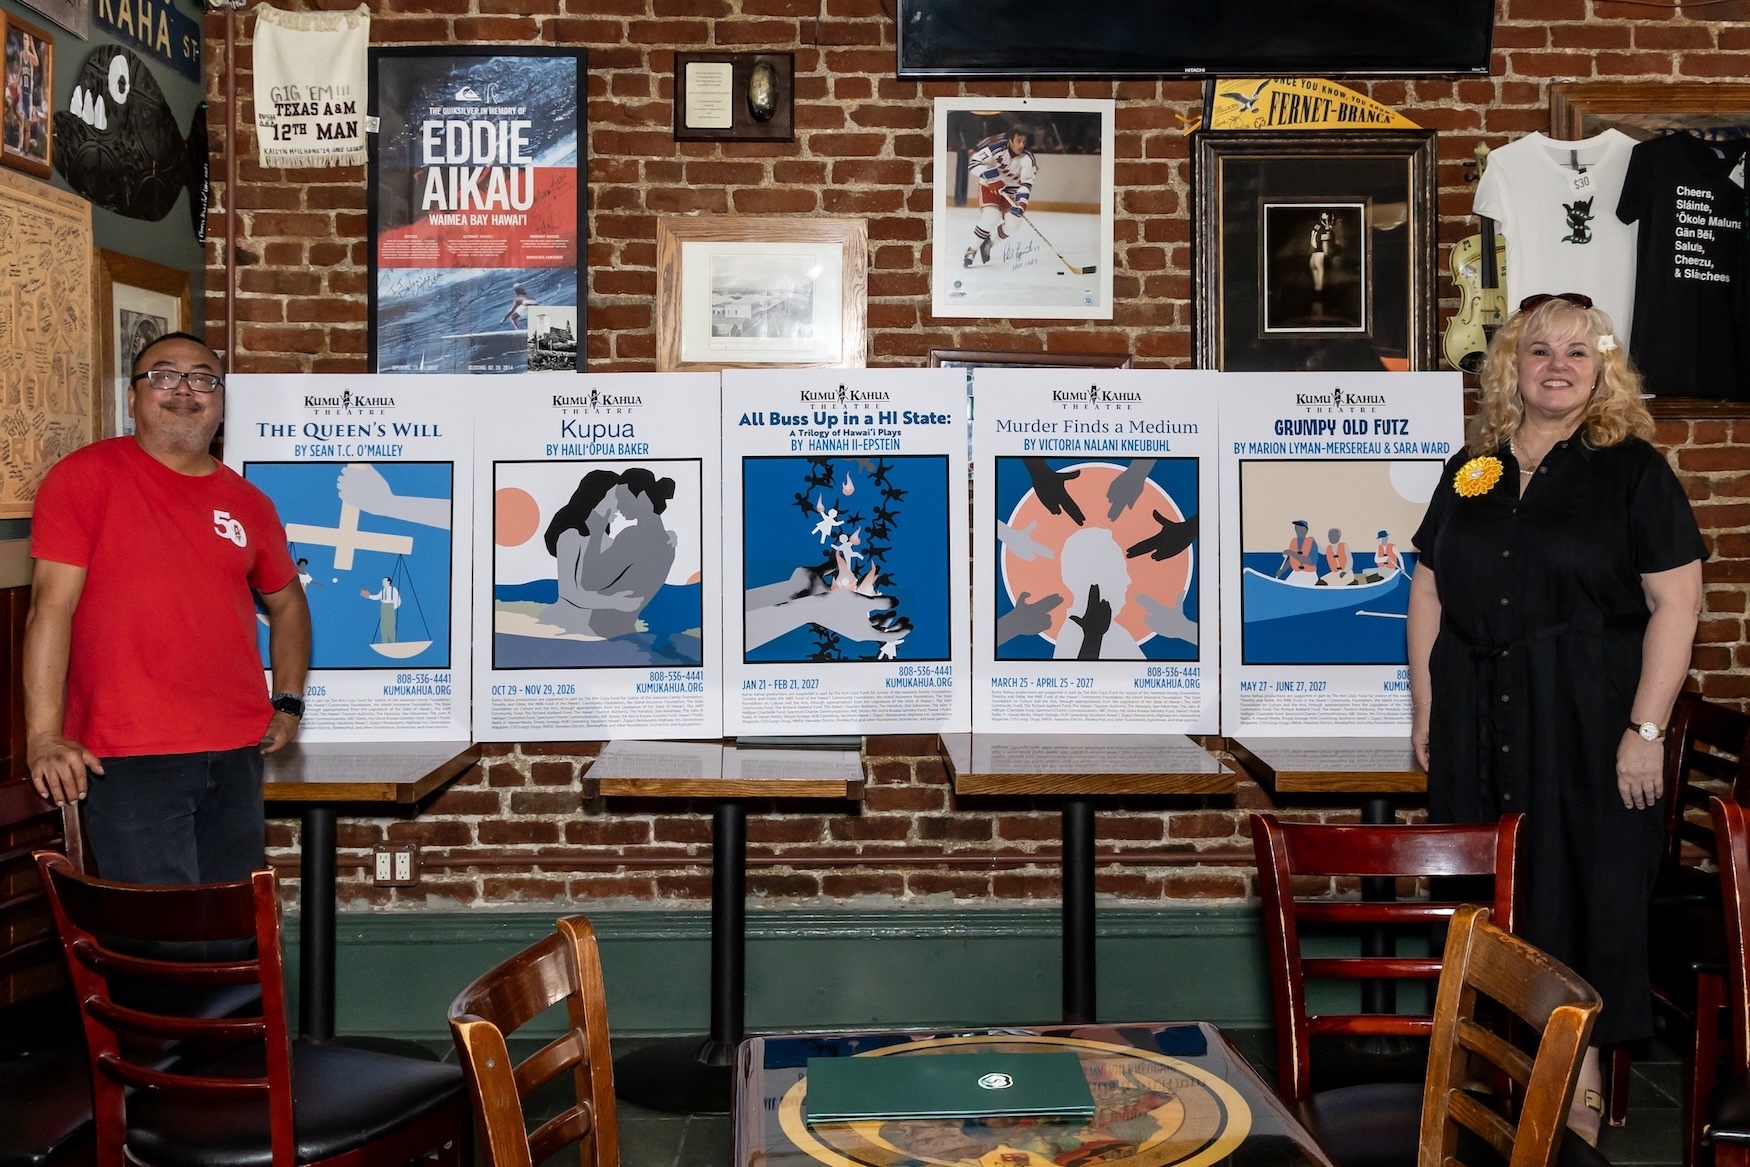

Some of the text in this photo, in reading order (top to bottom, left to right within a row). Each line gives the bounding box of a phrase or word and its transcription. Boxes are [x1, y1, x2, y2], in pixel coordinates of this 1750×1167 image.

[270, 84, 300, 103] GIG
[1301, 80, 1318, 91] YOU
[1322, 85, 1348, 100] KNOW,
[1351, 95, 1366, 105] YOU
[275, 102, 318, 116] TEXAS
[1267, 90, 1390, 126] FERNET-BRANCA
[274, 121, 358, 140] 12TH MAN
[422, 120, 532, 165] EDDIE
[422, 166, 534, 210] AIKAU
[1574, 176, 1590, 190] $30
[1676, 186, 1714, 200] Cheers,
[1676, 199, 1712, 214] Sláinte,
[429, 214, 468, 226] WAIMEA
[470, 214, 488, 226] BAY
[1674, 268, 1681, 278] &
[553, 395, 642, 406] KUMU KAHUA
[800, 390, 890, 400] KUMU KAHUA
[1053, 390, 1142, 401] KUMU KAHUA
[1296, 394, 1386, 404] KUMU KAHUA
[304, 396, 395, 407] KUMU KAHUA
[739, 411, 952, 428] All Buss Up in a HI State:
[256, 423, 296, 437] THE
[392, 422, 442, 437] WILL
[562, 420, 635, 442] Kupua
[996, 419, 1198, 434] Murder Finds a Medium
[1274, 419, 1409, 436] GRUMPY OLD FUTZ
[798, 429, 829, 438] Trilogy
[878, 429, 902, 438] Plays
[546, 444, 558, 456] BY
[618, 443, 649, 455] BAKER
[791, 438, 900, 451] BY HANNAH II-EPSTEIN
[1024, 439, 1170, 451] BY VICTORIA NALANI KNEUBUHL
[1234, 442, 1450, 454] BY MARION LYMAN-MERSEREAU & SARA WARD
[294, 445, 403, 457] BY SEAN T.C. O'MALLEY
[650, 671, 704, 681] 808-536-4441
[899, 666, 952, 676] 808-536-4441
[1147, 667, 1200, 677] 808-536-4441
[397, 674, 451, 684] 808-536-4441
[742, 680, 756, 690] JAN
[759, 680, 766, 689] 21
[774, 680, 787, 689] FEB
[789, 679, 800, 691] 21,
[802, 679, 819, 689] 2027
[886, 677, 952, 688] KUMUKAHUA.ORG
[992, 678, 1017, 687] MARCH
[1020, 678, 1028, 687] 25
[1036, 678, 1057, 687] APRIL
[1060, 678, 1068, 687] 25
[1076, 678, 1094, 687] 2027
[1134, 678, 1200, 688] KUMUKAHUA.ORG
[383, 685, 451, 696] KUMUKAHUA.ORG
[492, 686, 506, 695] OCT
[508, 686, 517, 695] 29
[525, 685, 542, 695] NOV
[544, 685, 555, 696] 29,
[557, 684, 575, 694] 2026
[636, 682, 704, 693] KUMUKAHUA.ORG
[1240, 682, 1257, 691] MAY
[1259, 682, 1267, 691] 27
[1275, 682, 1294, 691] JUNE
[1297, 682, 1307, 693] 27,
[1309, 681, 1326, 691] 2027
